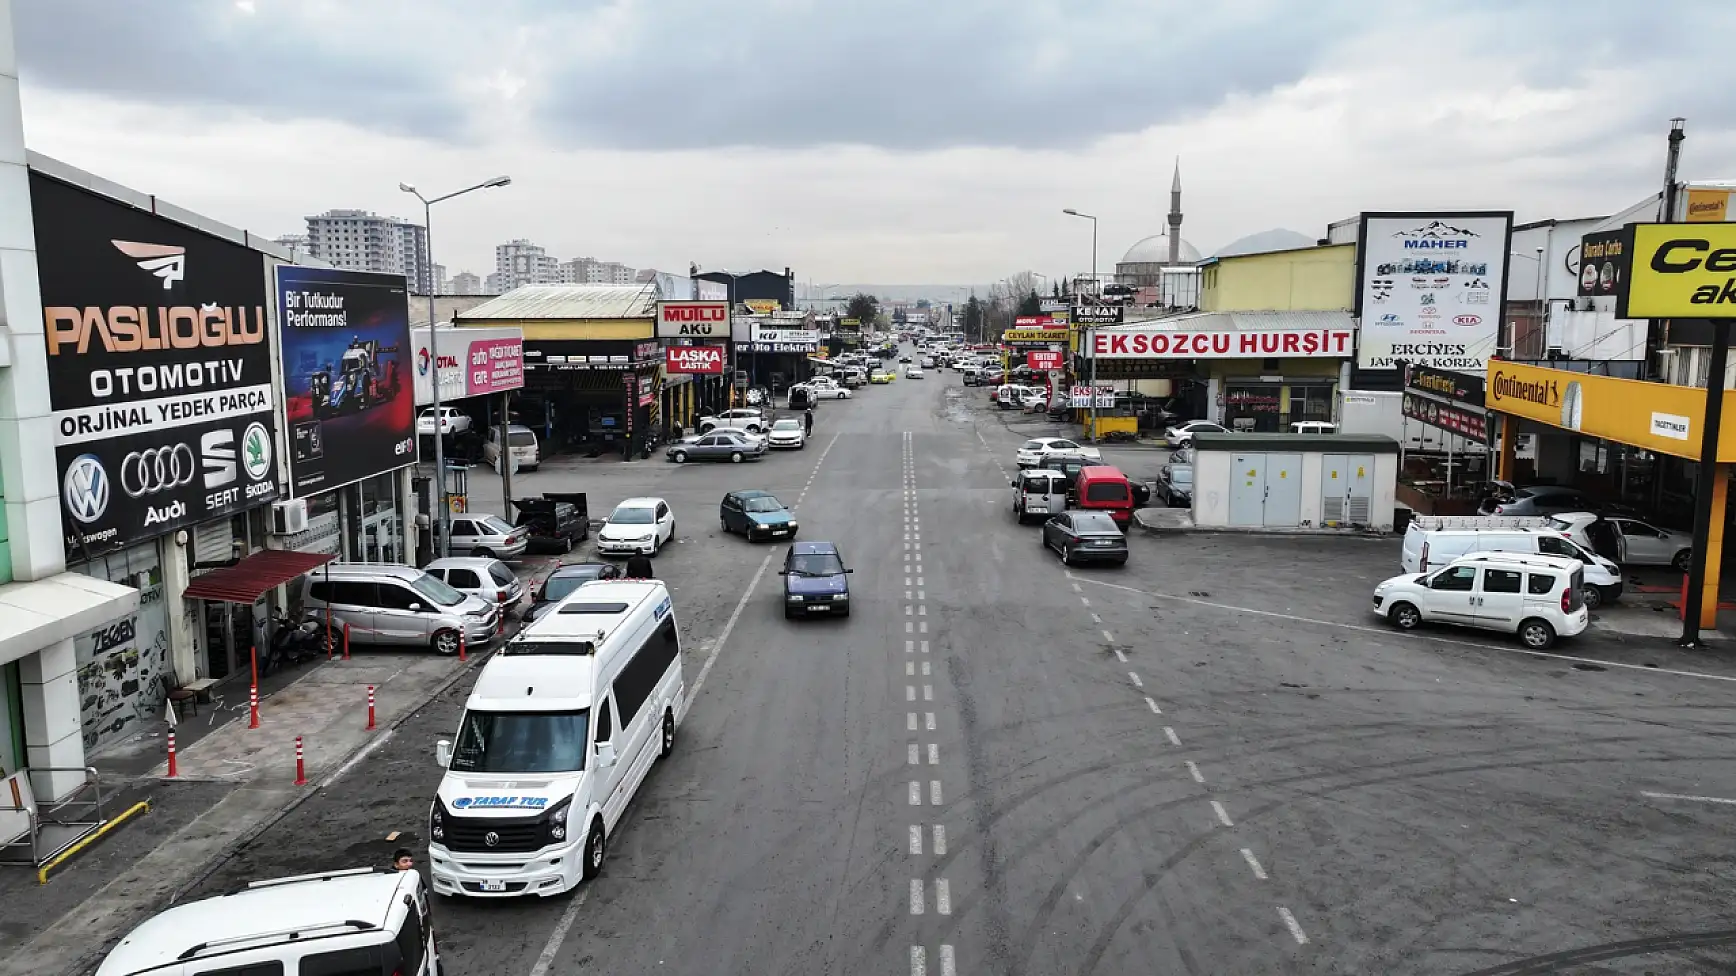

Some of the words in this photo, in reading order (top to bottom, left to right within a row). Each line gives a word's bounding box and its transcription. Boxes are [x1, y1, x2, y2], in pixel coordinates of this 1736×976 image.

[1690, 203, 1720, 215] Continental
[1404, 240, 1468, 249] MAHER
[285, 290, 301, 308] Bir
[302, 291, 344, 309] Tutkudur
[286, 310, 347, 327] Performans!
[664, 306, 725, 322] MUTLU
[1076, 307, 1119, 316] KENAN
[45, 302, 264, 356] PASLIOĞLU
[679, 323, 712, 335] AKÜ
[773, 342, 816, 353] Elektrik
[1094, 333, 1230, 355] EKSOZCU
[1240, 330, 1351, 355] HURŞİT
[1391, 341, 1466, 355] ERCİYES
[436, 356, 459, 369] OTAL
[472, 348, 488, 365] auto
[669, 350, 721, 362] LASKA
[1369, 357, 1414, 368] JAPN
[1432, 357, 1482, 368] KOREA
[474, 371, 488, 385] care
[1493, 370, 1549, 406] Continental
[60, 406, 153, 437] ORJİNAL
[157, 397, 215, 422] YEDEK
[220, 390, 266, 412] PARÇA
[205, 487, 240, 510] SEAT
[144, 500, 187, 527] Audi
[473, 796, 519, 805] TARAF
[520, 797, 549, 805] TUR
